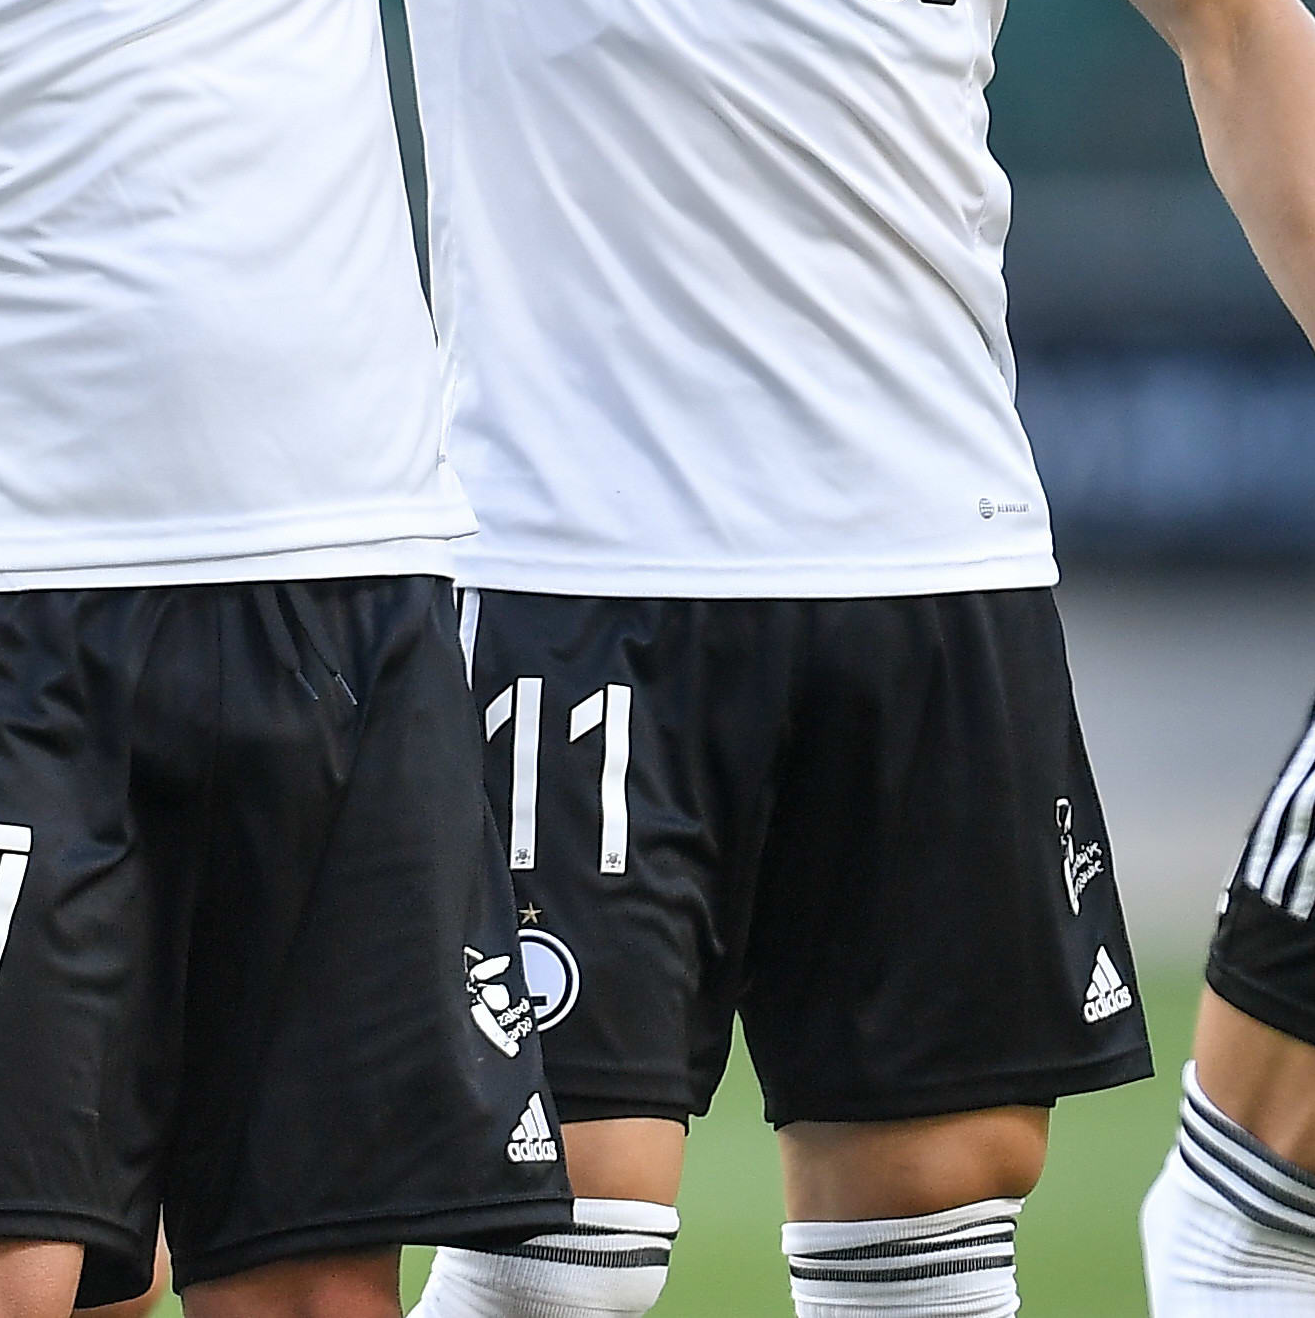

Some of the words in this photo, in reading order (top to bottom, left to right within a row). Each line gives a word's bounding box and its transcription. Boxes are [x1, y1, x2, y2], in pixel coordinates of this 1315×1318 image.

[485, 676, 633, 875] 11
[1084, 985, 1133, 1024] adidas
[507, 1139, 558, 1162] adidas
